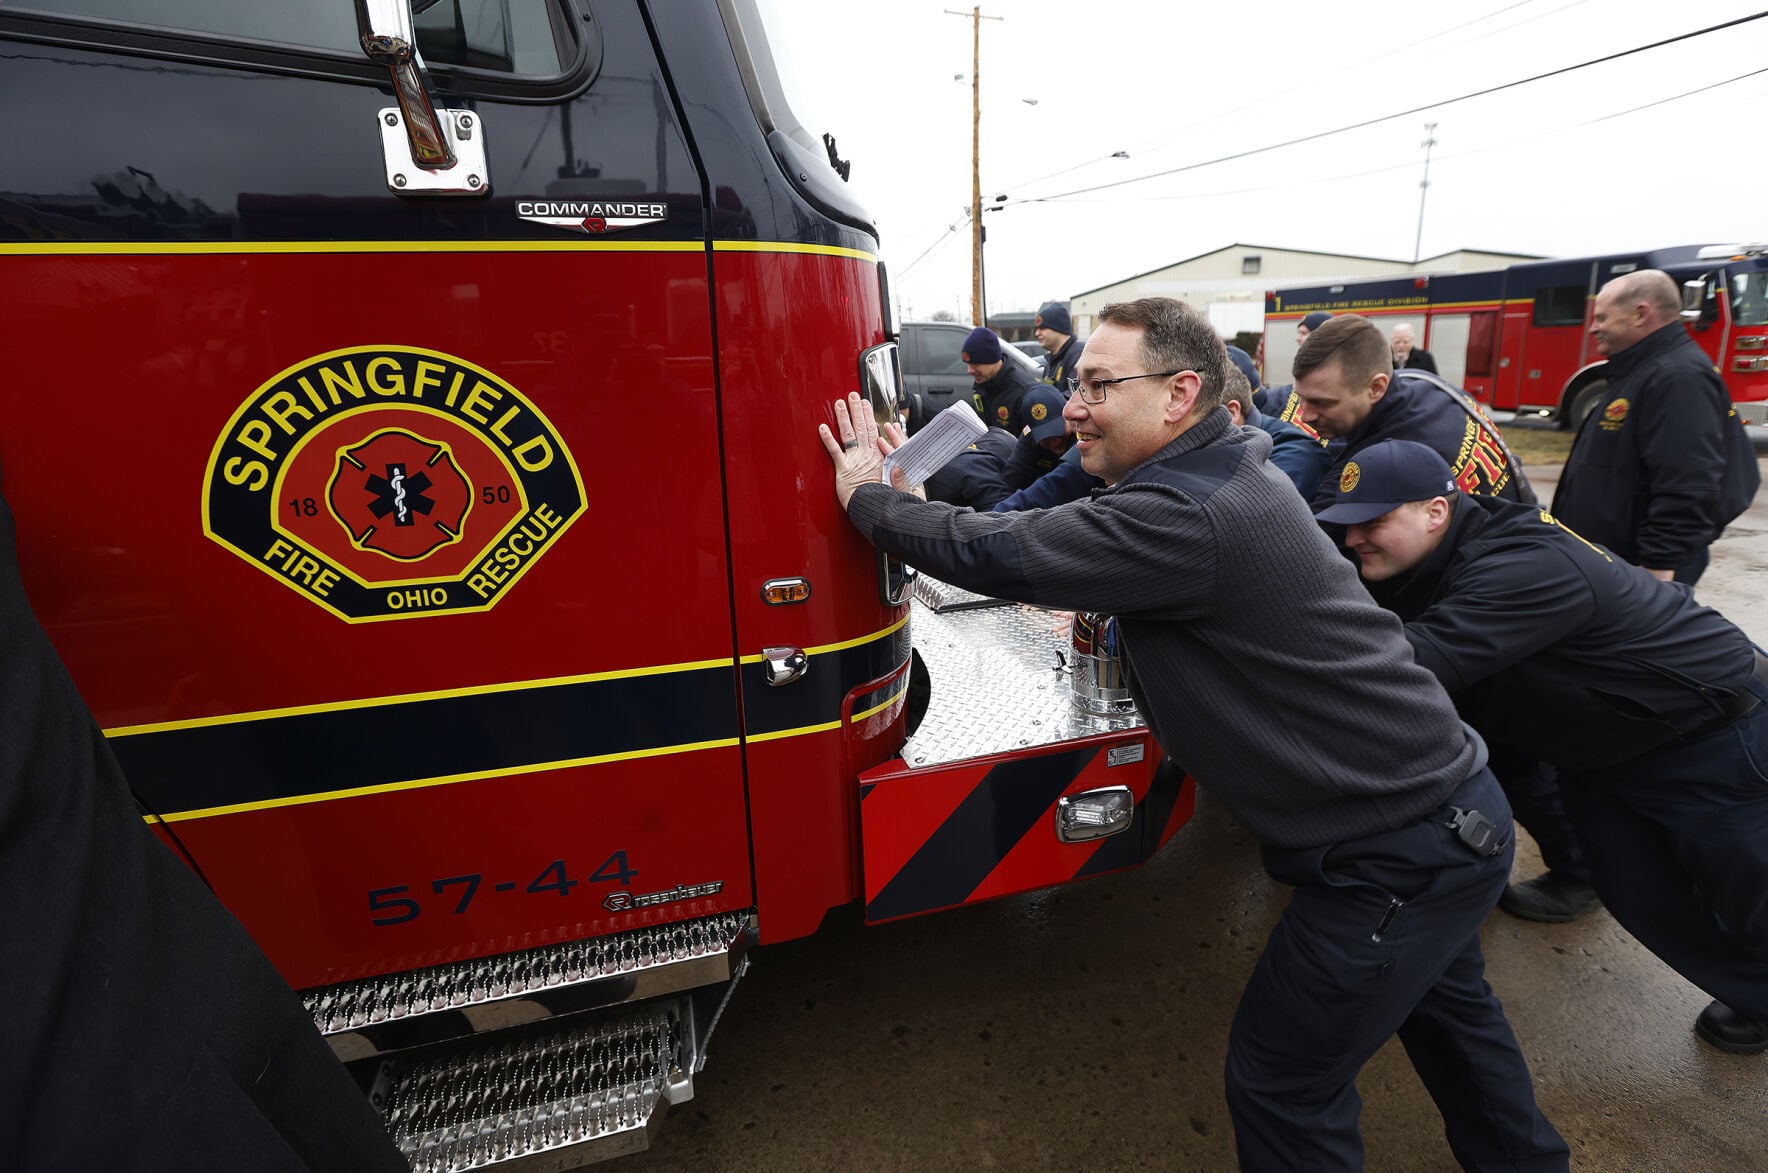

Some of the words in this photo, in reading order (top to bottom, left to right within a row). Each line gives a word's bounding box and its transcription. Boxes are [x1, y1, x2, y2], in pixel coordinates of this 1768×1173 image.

[518, 202, 664, 217] COMMANDER
[1275, 296, 1282, 312] 1
[1352, 299, 1385, 308] RESCUE
[1389, 297, 1428, 305] DIVISION
[224, 357, 553, 491] SPRINGFIELD
[482, 485, 511, 505] 50
[289, 497, 318, 517] 18
[467, 503, 562, 599] RESCUE
[264, 539, 341, 597] FIRE
[387, 587, 448, 609] OHIO
[368, 850, 639, 926] 57-44
